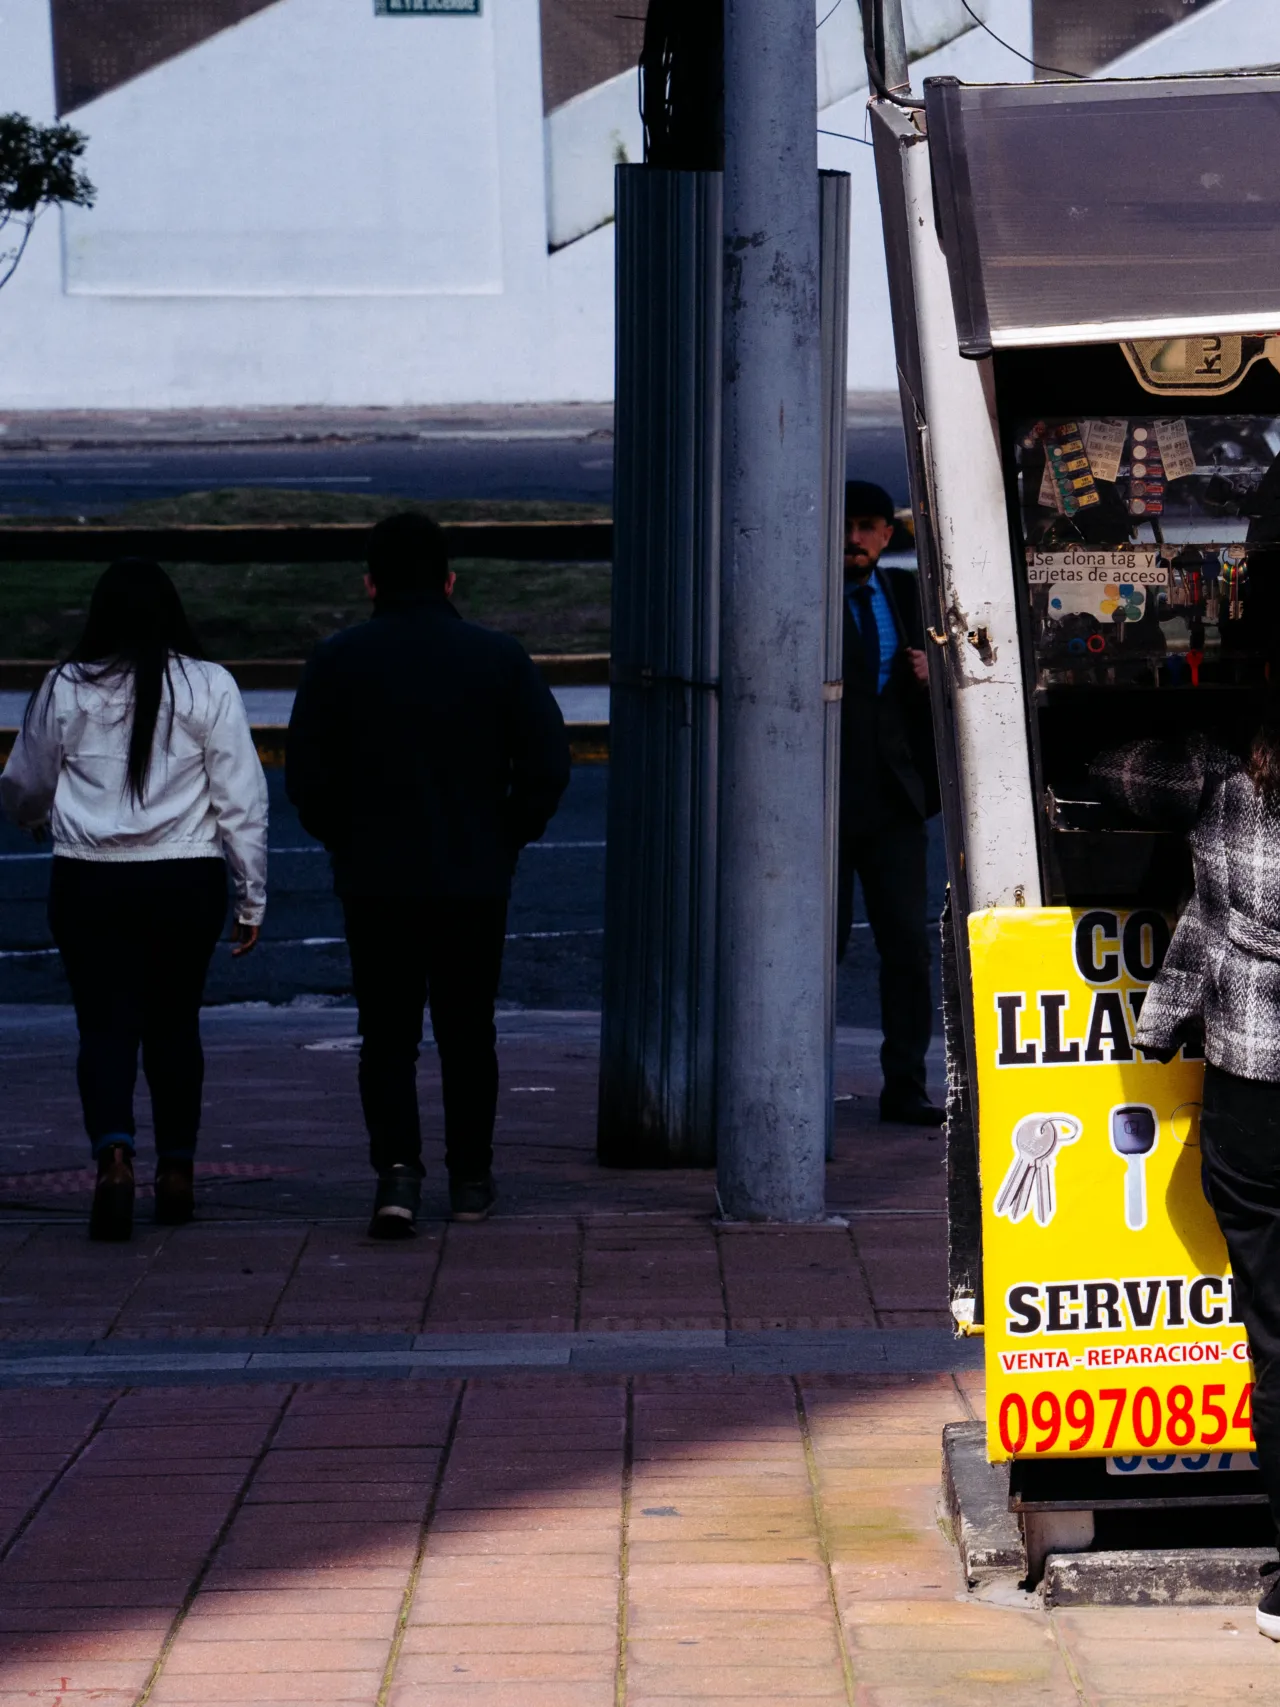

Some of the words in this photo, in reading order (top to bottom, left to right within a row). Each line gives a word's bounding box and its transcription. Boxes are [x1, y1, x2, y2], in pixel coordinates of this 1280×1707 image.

[1035, 552, 1054, 566] Se
[1063, 552, 1106, 566] clona
[1111, 553, 1136, 568] tag
[1145, 554, 1155, 568] y
[1088, 567, 1108, 582] de
[1112, 572, 1166, 583] acceso
[1073, 908, 1170, 984] CO
[1002, 1351, 1070, 1371] VENTA
[998, 1382, 1256, 1454] 09970854
